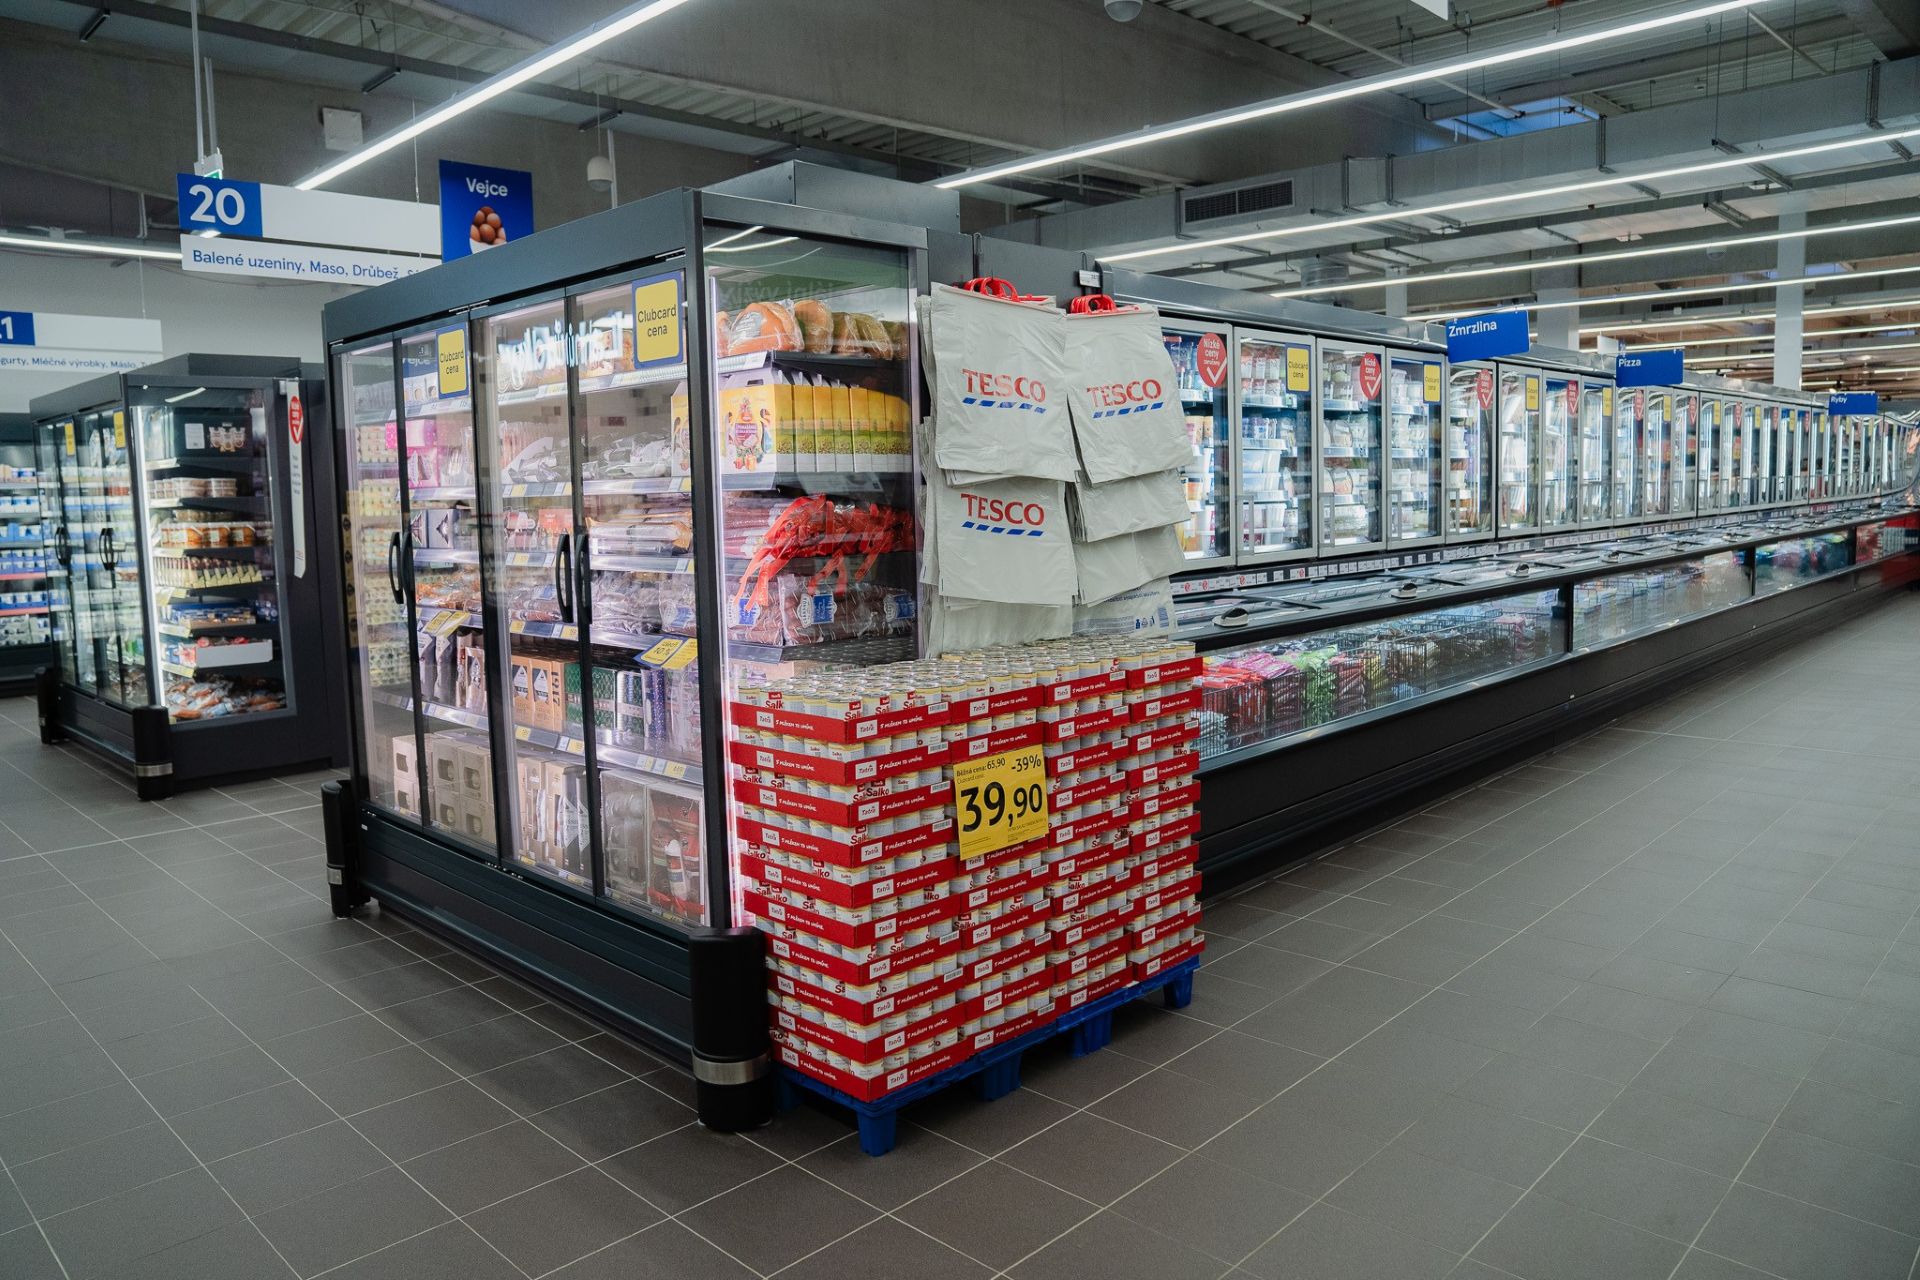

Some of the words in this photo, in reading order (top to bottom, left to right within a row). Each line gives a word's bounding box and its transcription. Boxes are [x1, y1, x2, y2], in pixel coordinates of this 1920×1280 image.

[465, 177, 508, 198] Vejce
[188, 184, 246, 226] 20
[193, 250, 244, 265] Balené
[310, 261, 349, 277] Maso,
[637, 303, 677, 324] Clubcard
[0, 316, 14, 340] 1
[647, 324, 668, 338] cena
[1448, 320, 1498, 338] Zmrzlina
[32, 357, 66, 366] Mléčné
[439, 350, 465, 365] Clubcard
[1204, 349, 1220, 360] ceny
[1618, 358, 1641, 367] Pizza
[445, 364, 459, 375] cena
[1293, 371, 1304, 379] cena
[961, 369, 1046, 403] TESCO
[1087, 378, 1163, 411] TESCO
[1830, 396, 1847, 405] Ryby
[961, 493, 1045, 527] TESCO
[956, 767, 973, 777] Běžná
[987, 757, 1006, 770] 65,90
[1011, 754, 1042, 773] -39%
[866, 787, 890, 797] Salko
[960, 781, 1043, 832] 39,90
